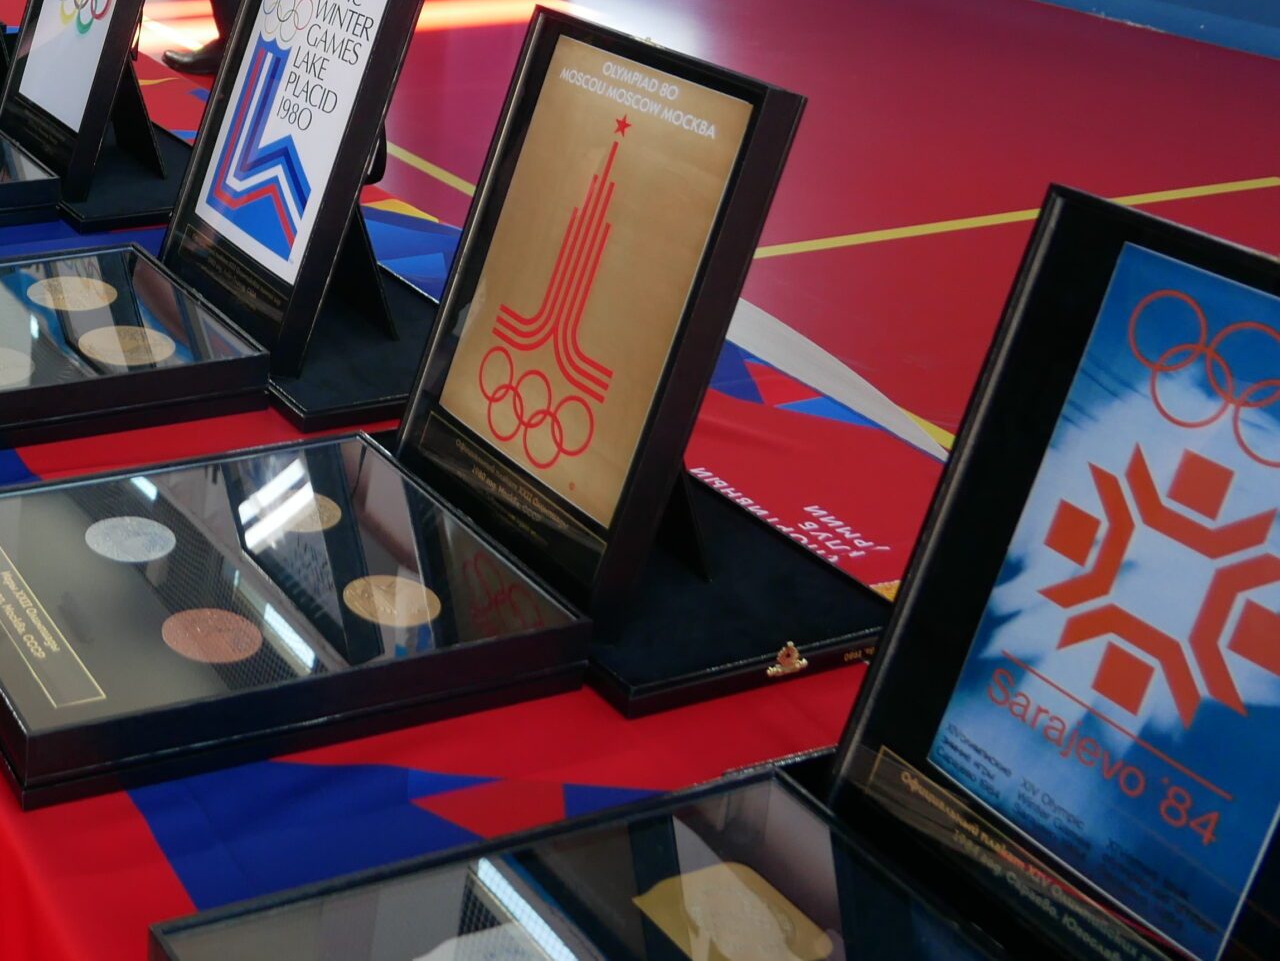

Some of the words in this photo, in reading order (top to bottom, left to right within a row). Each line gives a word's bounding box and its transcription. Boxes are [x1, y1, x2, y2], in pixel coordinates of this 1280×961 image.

[293, 46, 330, 81] LAKE
[307, 23, 363, 66] GAMES
[285, 71, 338, 114] PLACID
[559, 67, 608, 95] MOSCOU
[606, 84, 662, 116] MOSCOW
[602, 62, 659, 93] OLYMPIAD
[659, 82, 679, 101] 80
[276, 95, 313, 131] 1980
[986, 667, 1146, 798] Sarajevo
